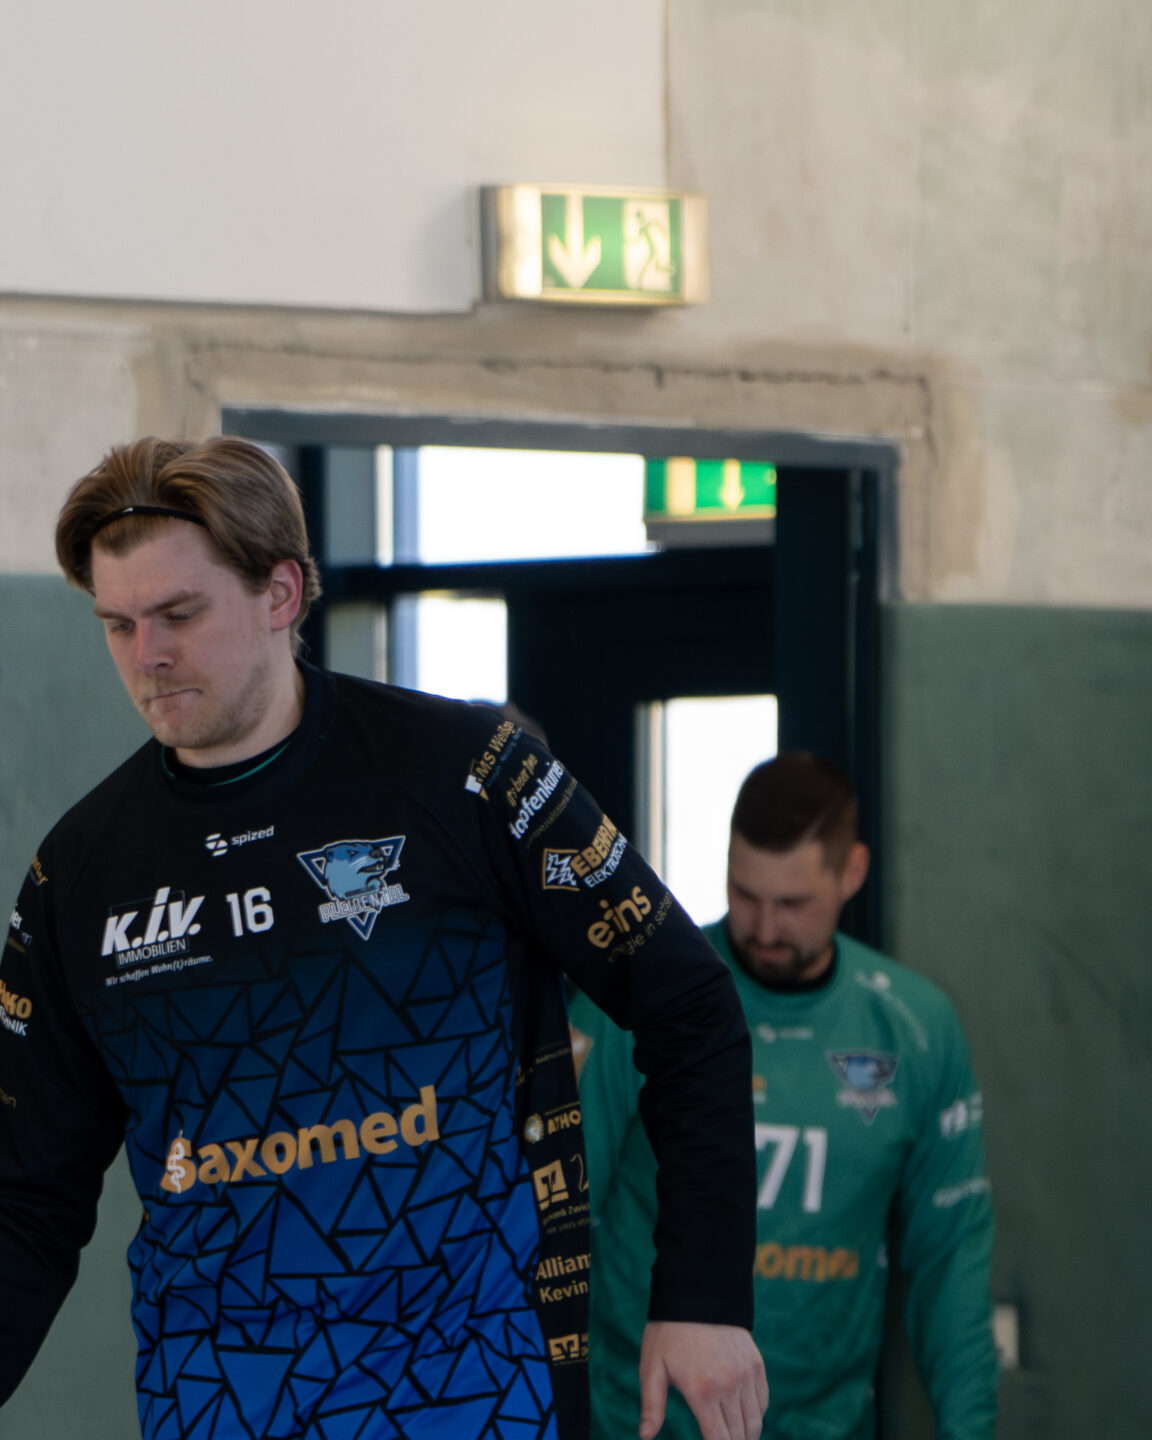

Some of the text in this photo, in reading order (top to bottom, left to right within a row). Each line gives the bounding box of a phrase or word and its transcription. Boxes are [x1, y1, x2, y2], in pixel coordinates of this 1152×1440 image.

[231, 826, 274, 846] spized
[225, 886, 275, 938] 16
[587, 886, 652, 949] eins
[117, 937, 187, 966] IMMOBILIEN
[534, 1252, 591, 1282] Allian
[538, 1280, 589, 1304] Kevin
